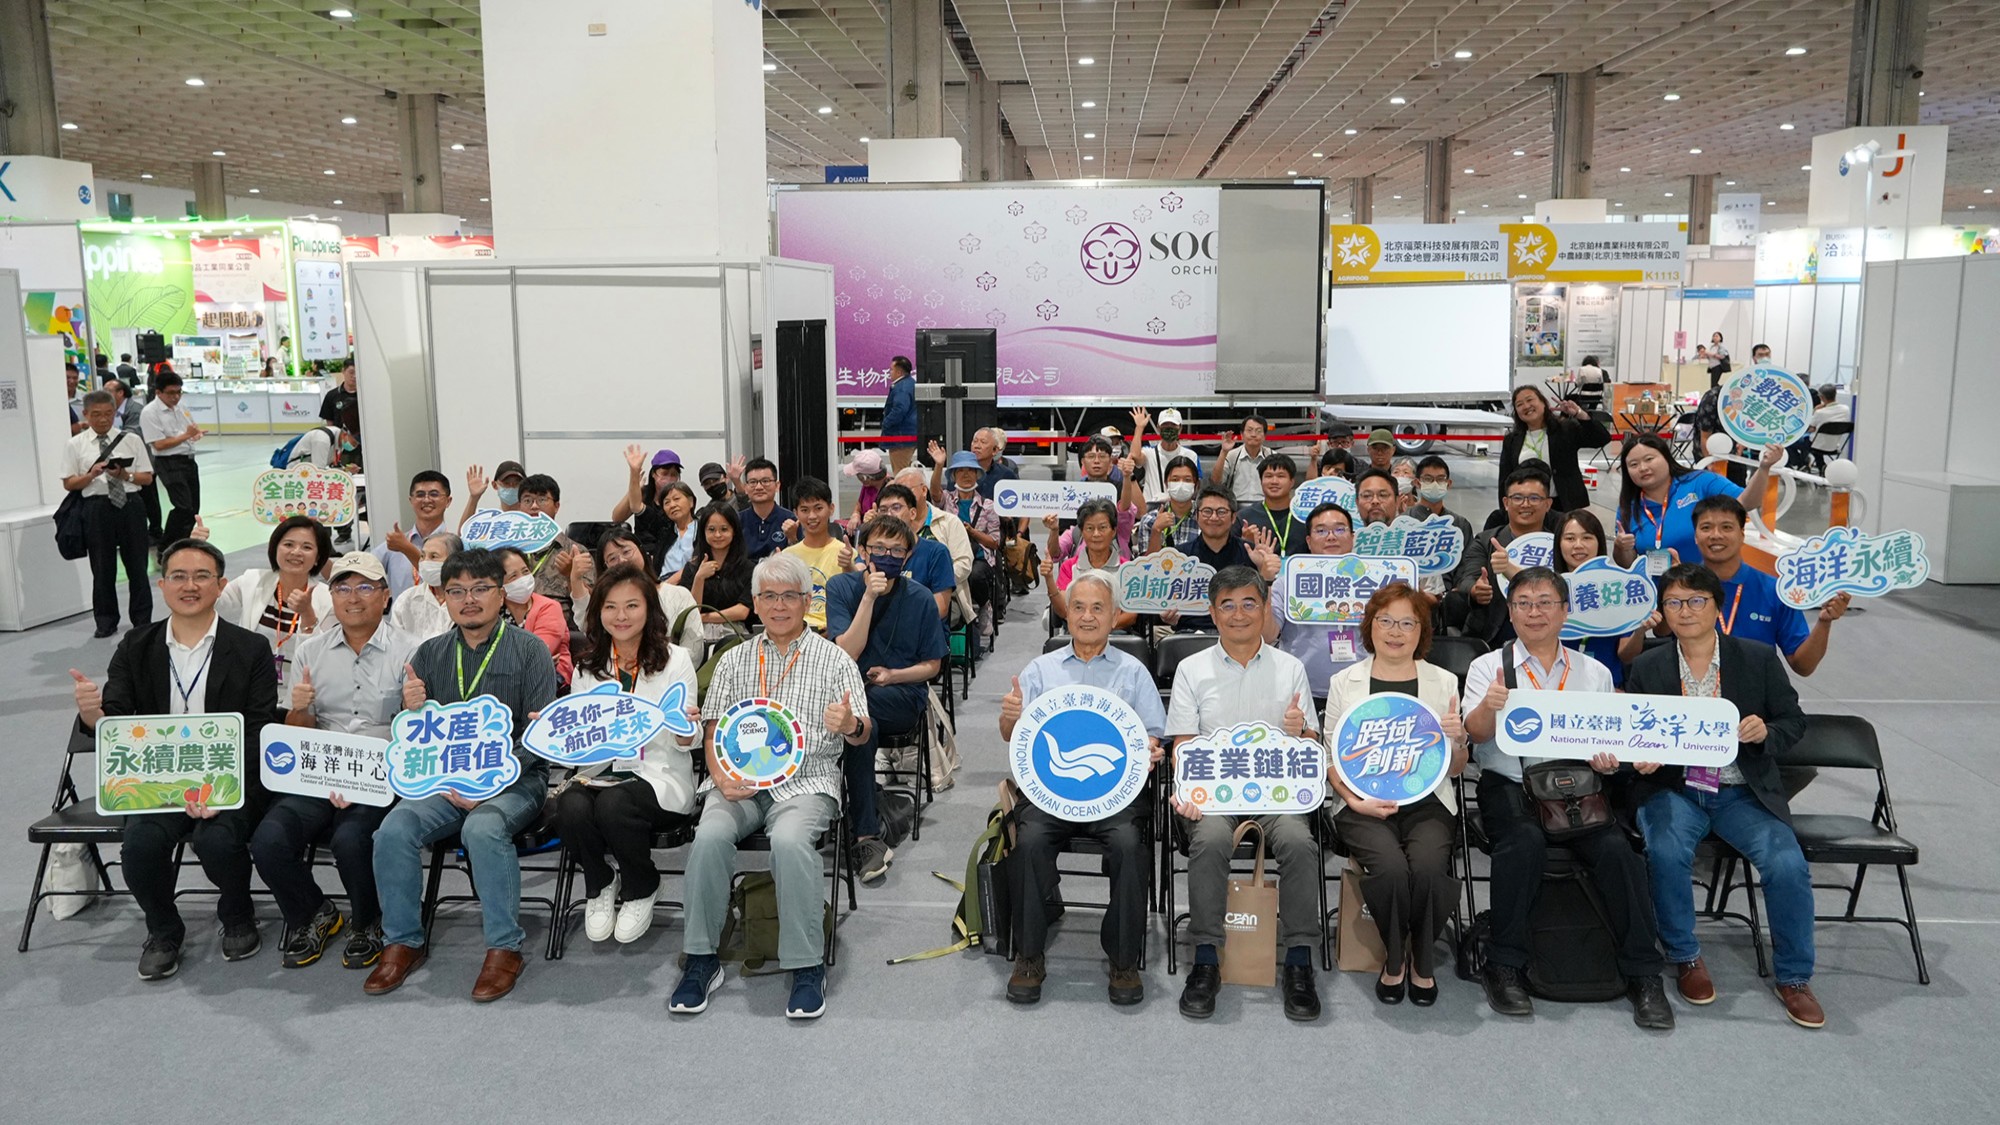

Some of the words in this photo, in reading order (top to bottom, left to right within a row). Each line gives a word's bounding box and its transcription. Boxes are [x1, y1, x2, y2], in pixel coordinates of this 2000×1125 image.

[1882, 133, 1906, 177] J
[292, 235, 342, 257] Philippines
[1171, 265, 1217, 275] ORCHI
[1468, 271, 1502, 281] K1115
[1645, 271, 1680, 280] K1113
[1751, 377, 1803, 413] 數智
[263, 480, 345, 500] 全齡營養
[1355, 527, 1457, 558] 智慧藍海
[1784, 535, 1918, 590] 海洋永續
[1125, 574, 1209, 601] 創新創業
[406, 711, 479, 744] 水產
[548, 698, 636, 738] 魚你一起
[563, 711, 652, 753] 航向未來
[742, 727, 767, 735] SCIENCE
[1352, 714, 1424, 751] 跨域
[106, 742, 236, 775] 永續農業
[300, 740, 385, 763] 國立臺灣海洋大學
[1550, 735, 1589, 745] National
[1591, 737, 1624, 746] Taiwan
[1628, 734, 1669, 750] Ocean
[1683, 742, 1731, 754] University
[300, 752, 387, 781] 海洋中心
[403, 741, 505, 779] 新價值
[1016, 727, 1032, 779] NATIONAL
[1026, 779, 1061, 811] TAIWAN
[1062, 804, 1101, 817] OCEAN
[1104, 759, 1143, 811] UNIVERSITY
[1182, 746, 1319, 781] 產業鏈結
[1355, 742, 1425, 778] 創新
[300, 773, 323, 781] National
[324, 776, 342, 784] Taiwan
[360, 782, 388, 790] University
[324, 782, 351, 790] Excellence
